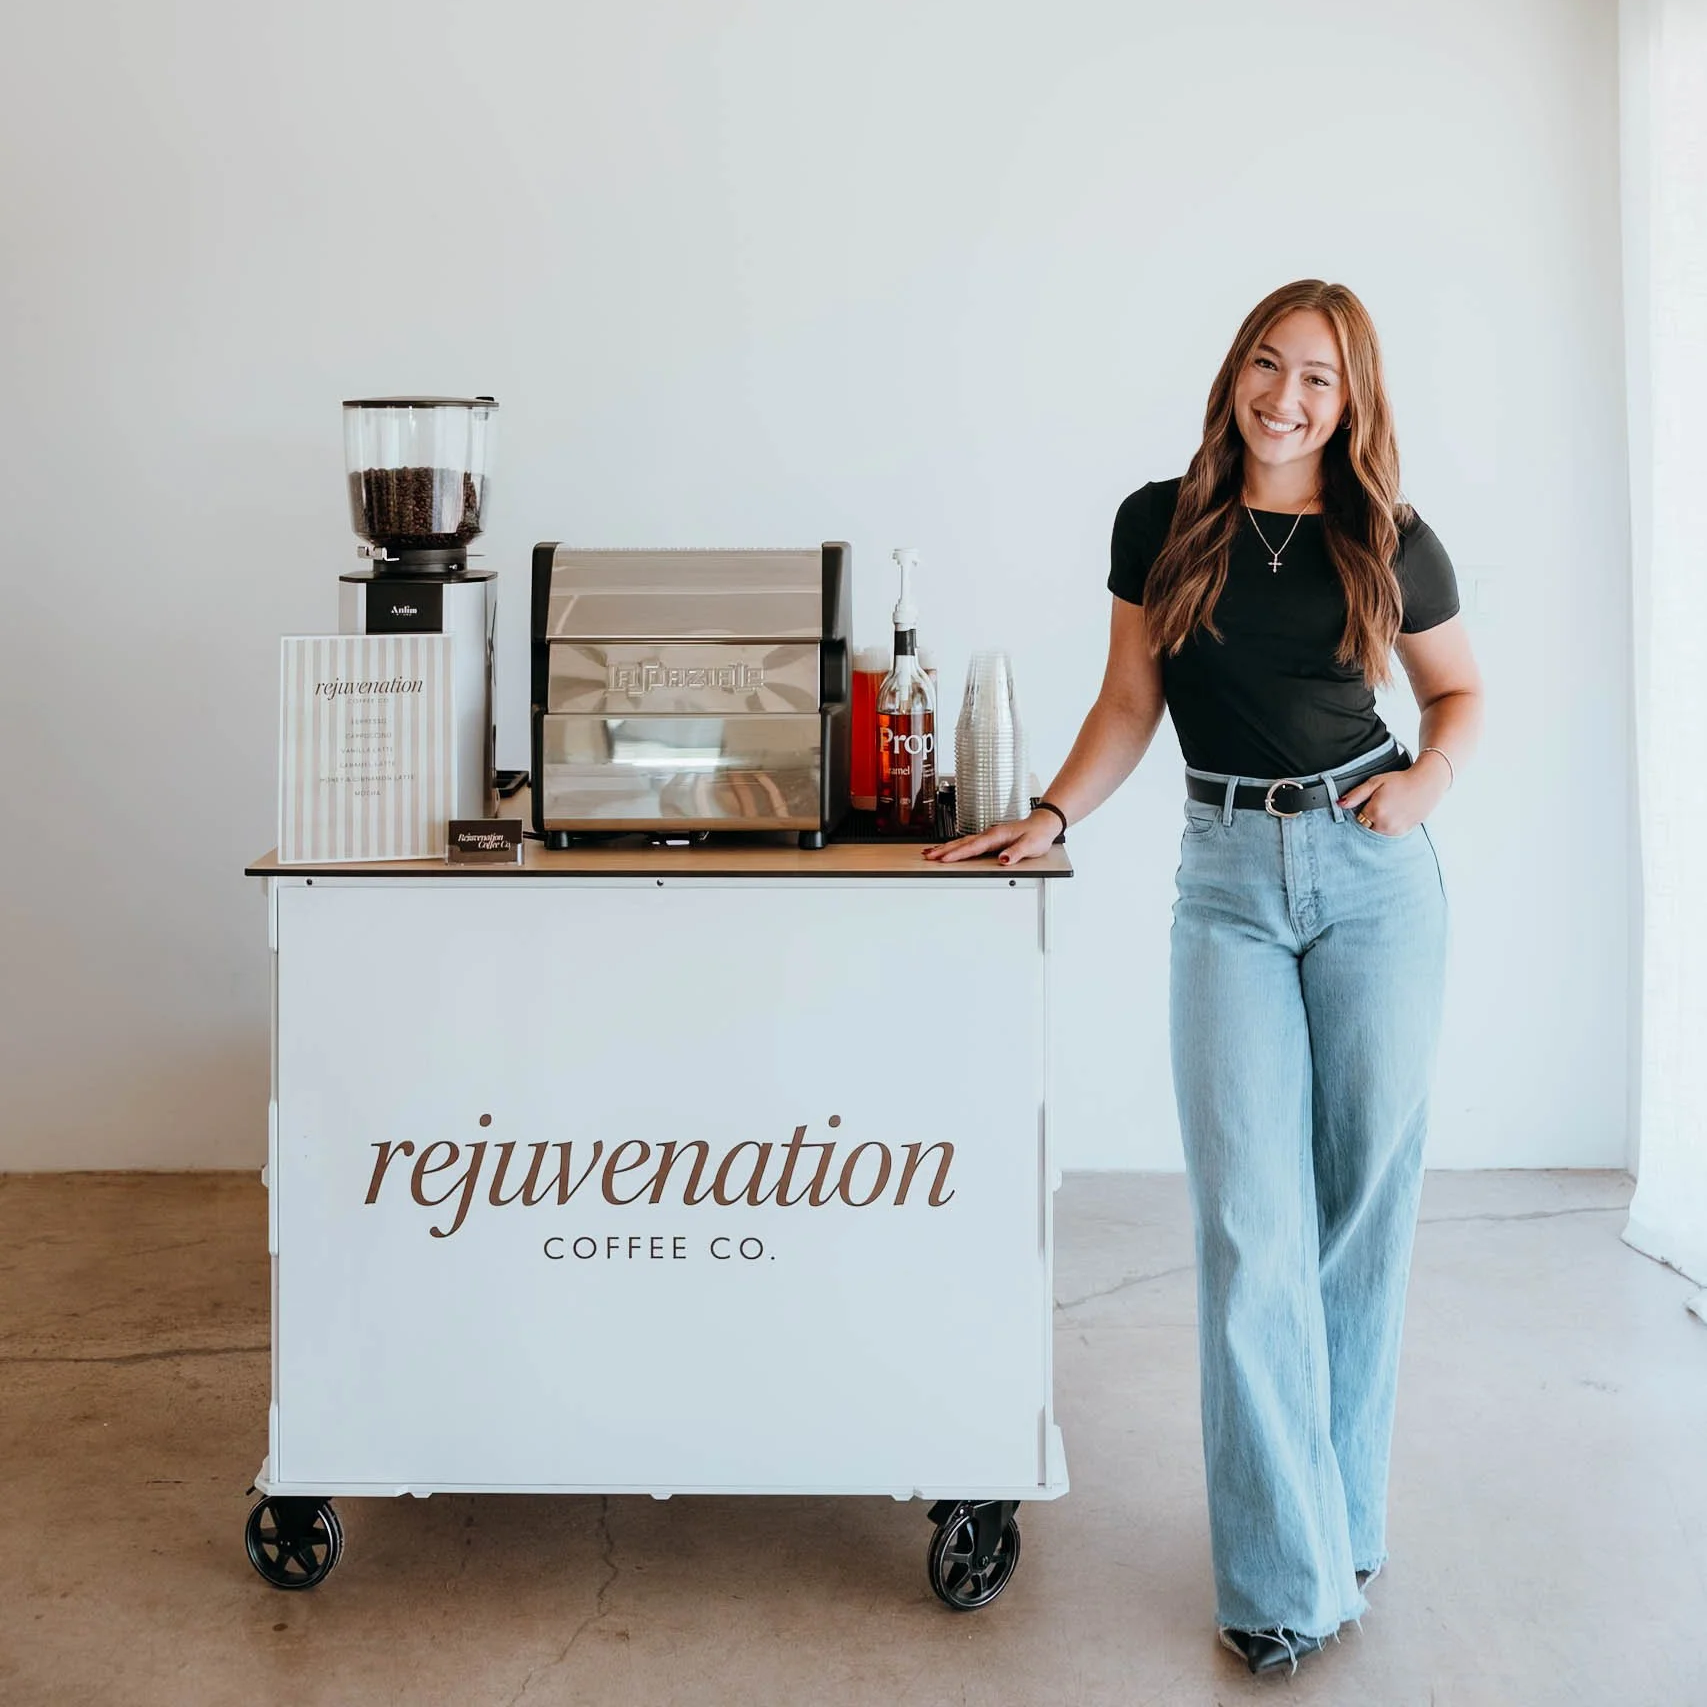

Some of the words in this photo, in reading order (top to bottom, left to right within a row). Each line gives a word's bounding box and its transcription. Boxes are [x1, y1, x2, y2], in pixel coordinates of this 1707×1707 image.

[315, 676, 423, 701] rejuvenation
[364, 1113, 956, 1239] rejuvenation
[543, 1236, 687, 1260] COFFEE
[710, 1236, 776, 1260] CO.
